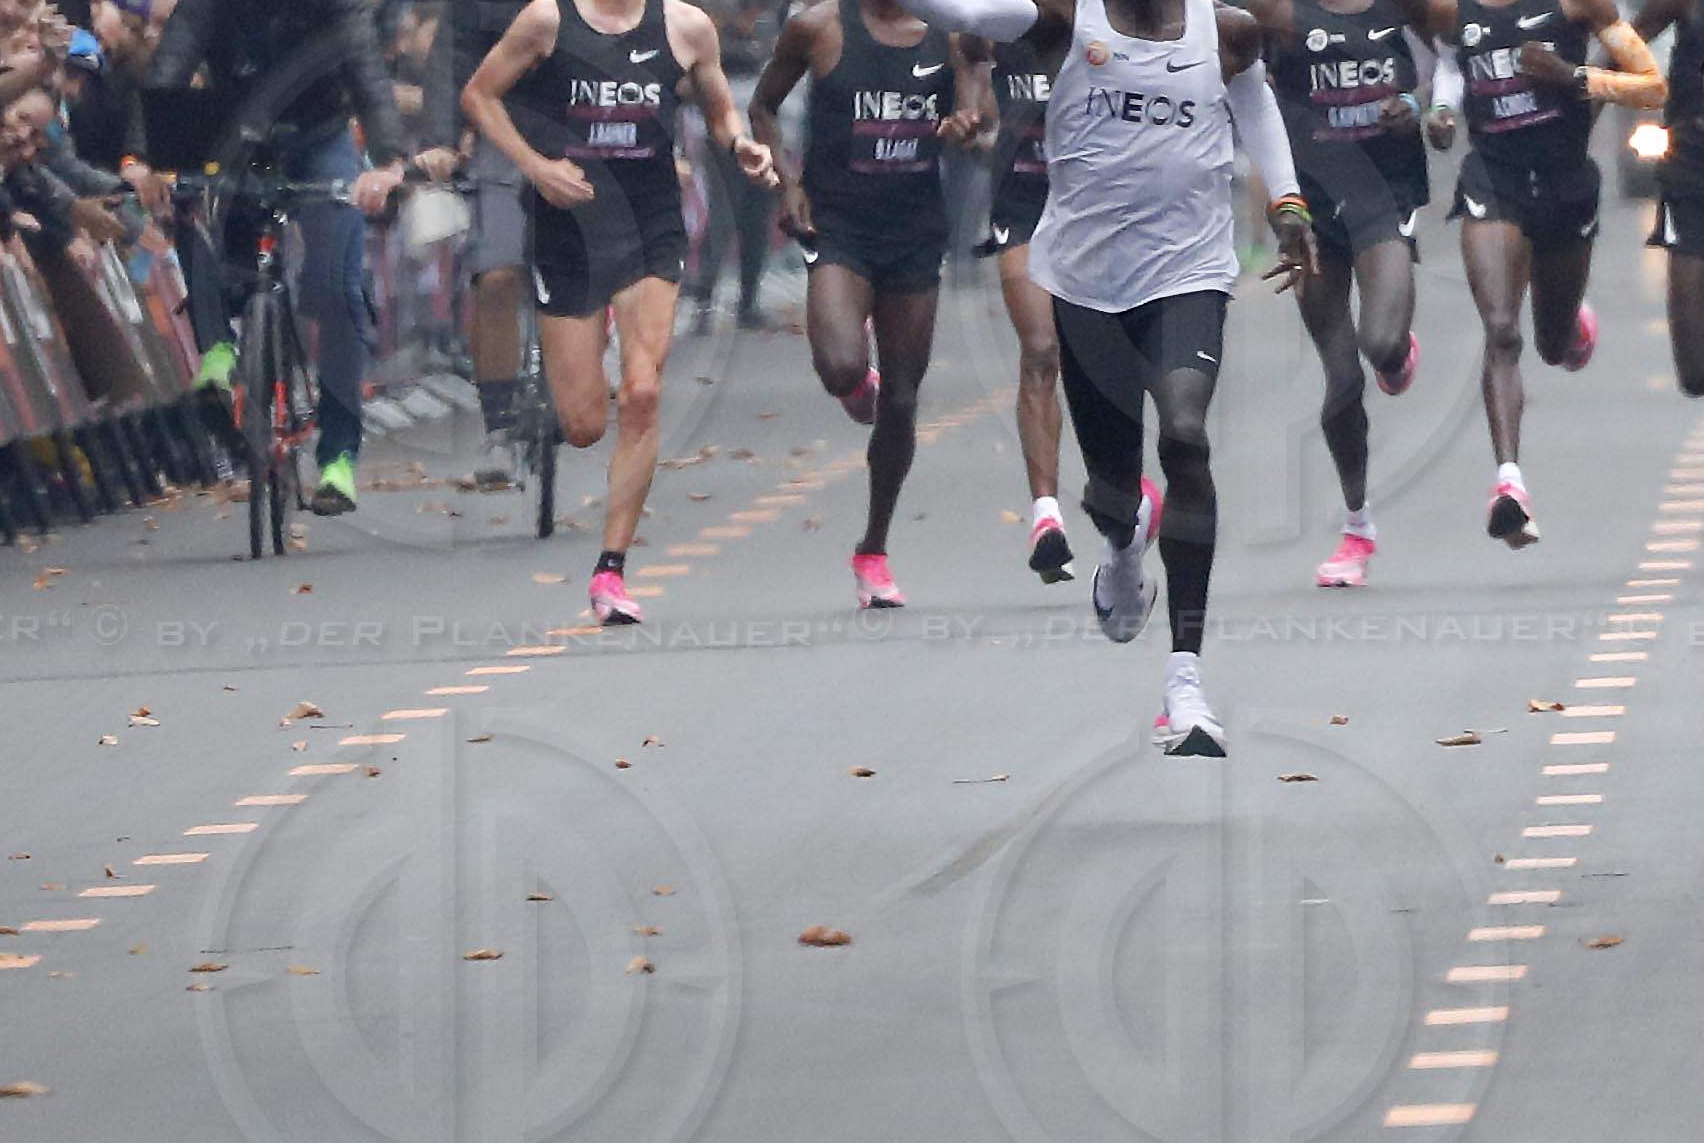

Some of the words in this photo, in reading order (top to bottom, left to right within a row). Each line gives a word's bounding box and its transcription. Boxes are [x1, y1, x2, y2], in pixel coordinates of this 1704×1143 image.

[1309, 57, 1395, 91] INEOS
[570, 78, 662, 107] INEOS
[853, 90, 939, 121] INEOS
[1084, 86, 1196, 128] INEOS
